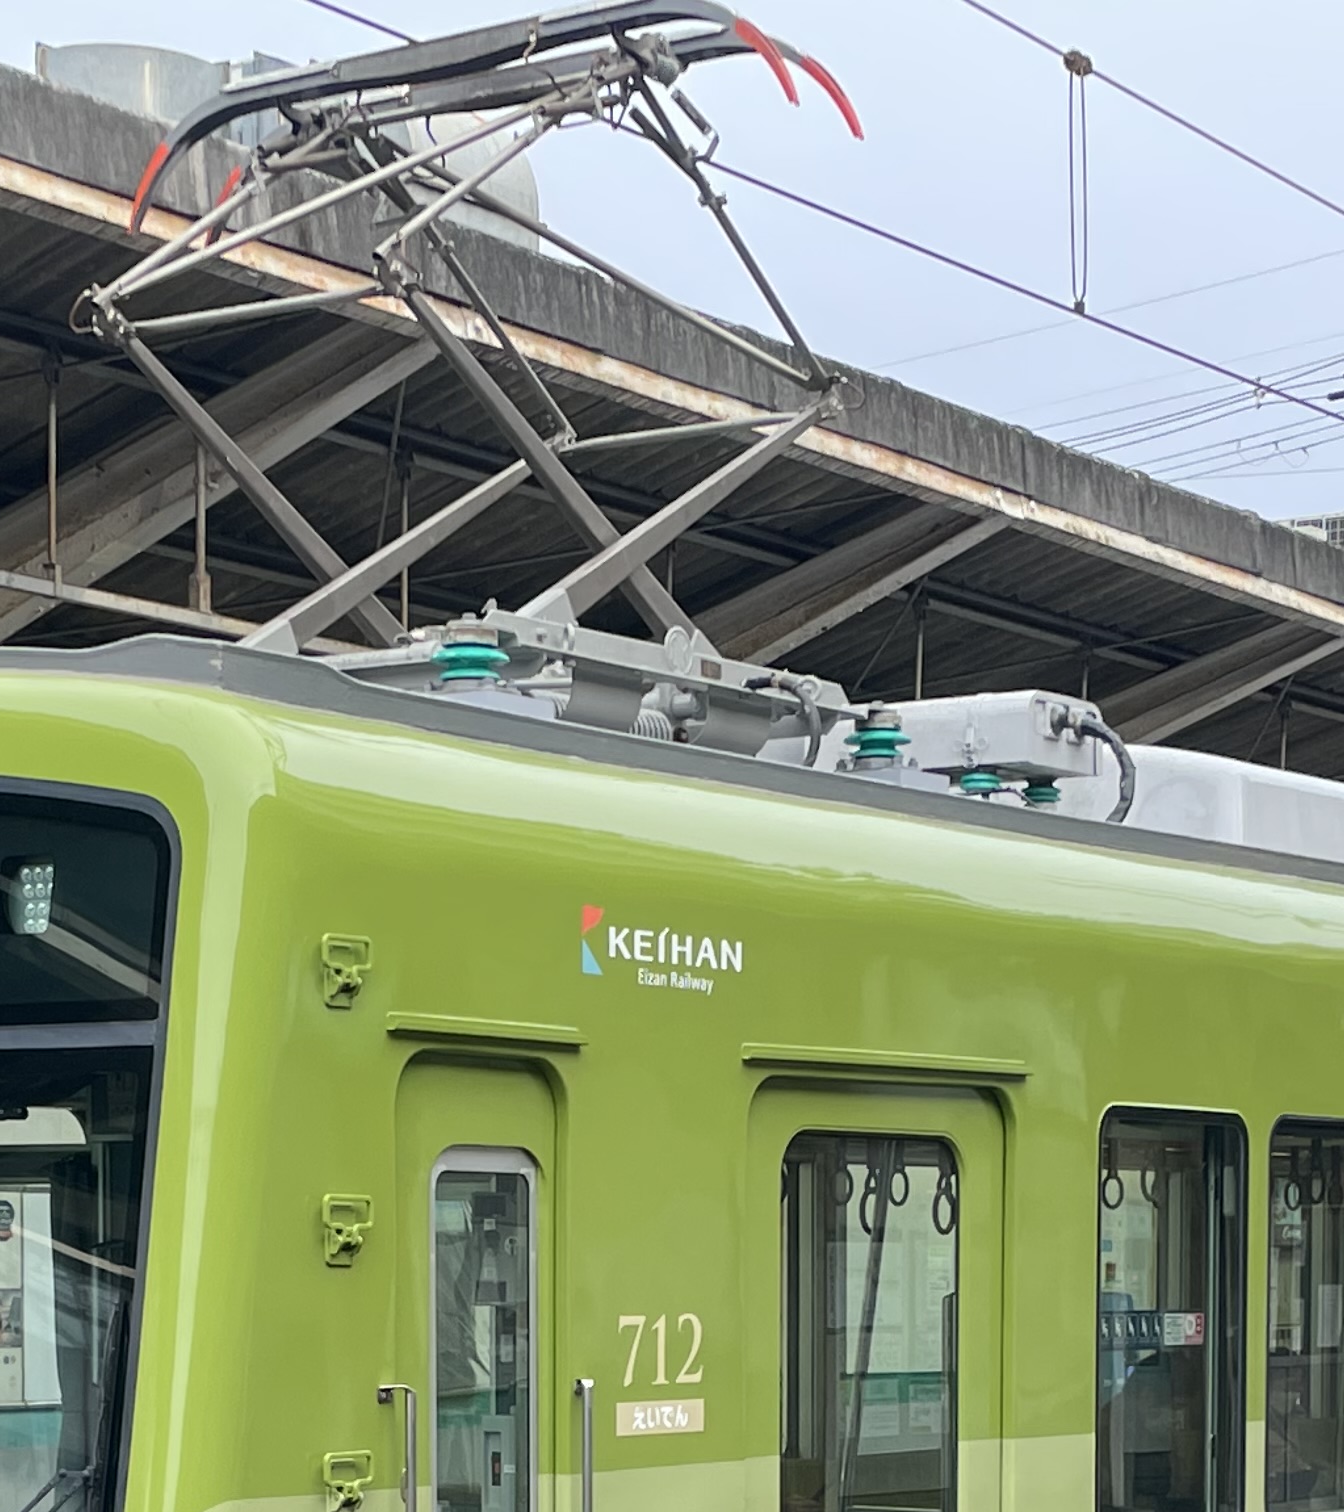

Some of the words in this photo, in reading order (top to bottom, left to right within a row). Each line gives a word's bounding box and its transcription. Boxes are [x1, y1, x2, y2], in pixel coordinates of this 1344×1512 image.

[608, 926, 743, 973] KEIHAN
[637, 967, 667, 987] Eizan
[670, 971, 714, 996] Railway
[617, 1312, 704, 1388] 712
[632, 1404, 689, 1431] えいでん
